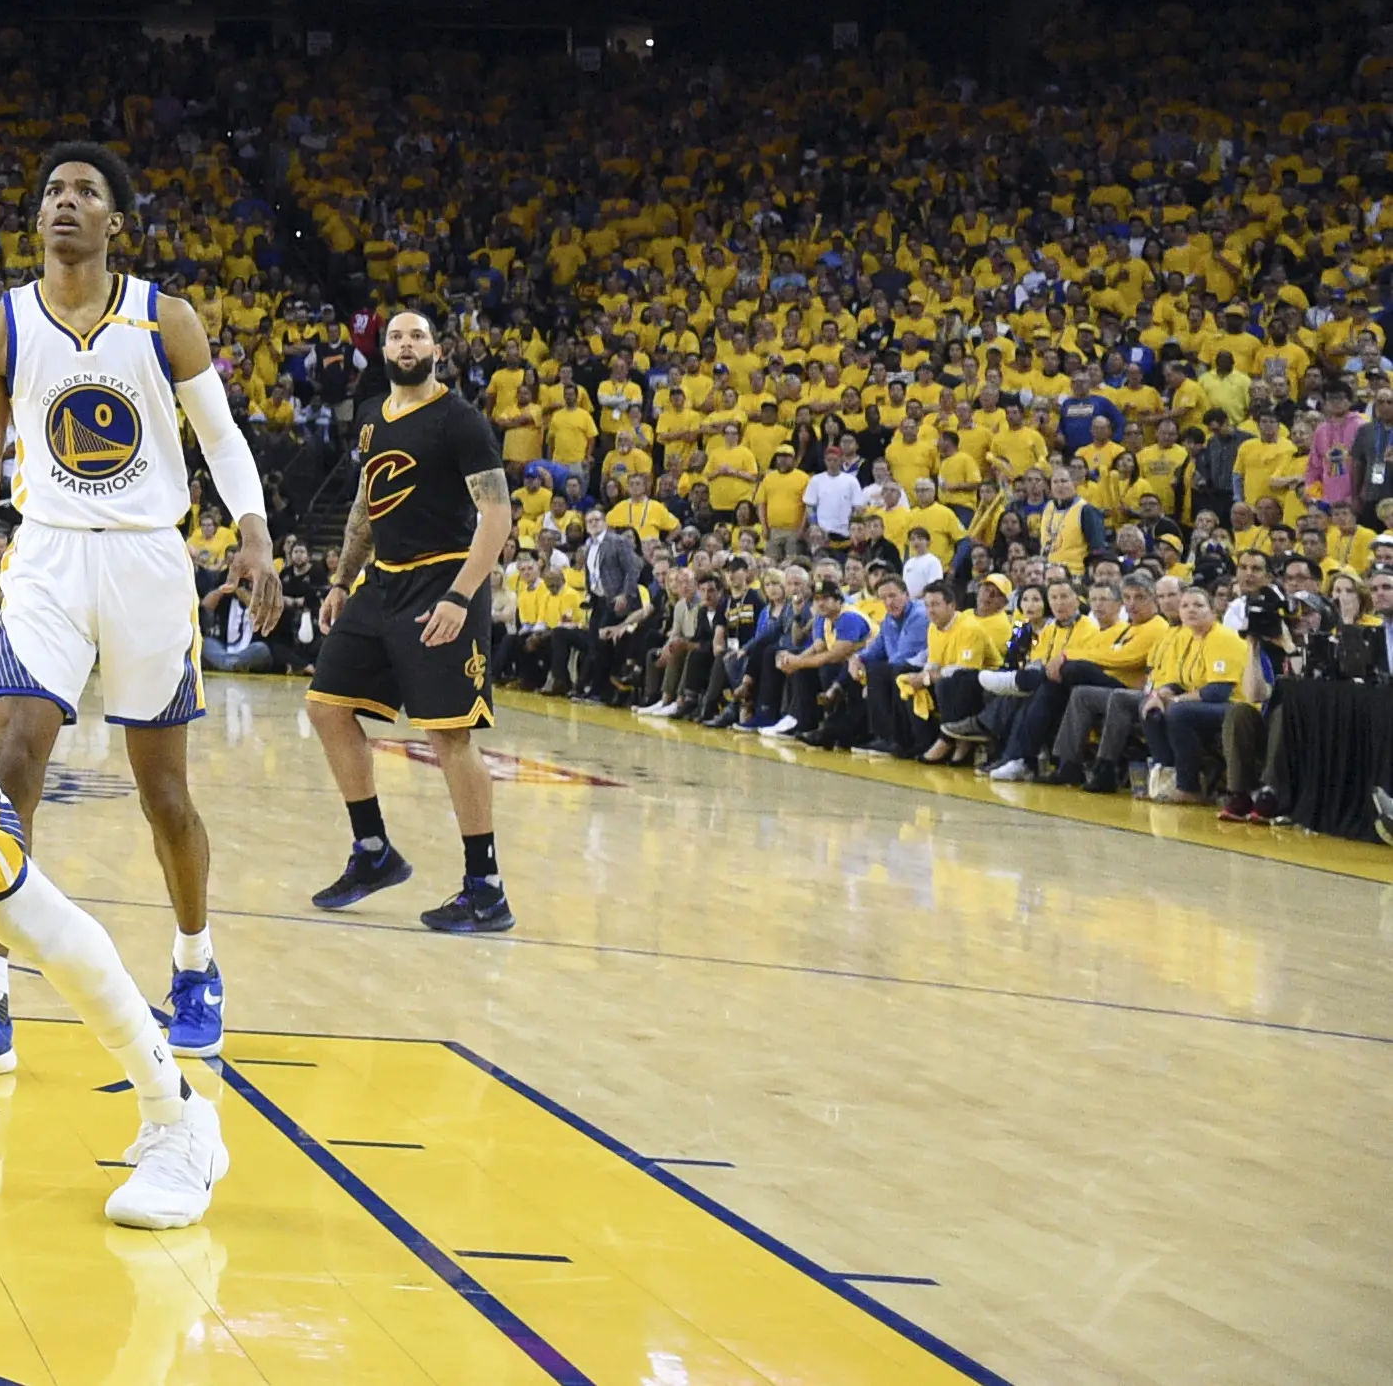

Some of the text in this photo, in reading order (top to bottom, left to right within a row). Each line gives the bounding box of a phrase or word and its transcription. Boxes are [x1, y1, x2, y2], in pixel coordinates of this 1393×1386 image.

[42, 373, 141, 407] GOLDEN STATE
[95, 403, 113, 428] 0
[50, 457, 148, 496] WARRIORS
